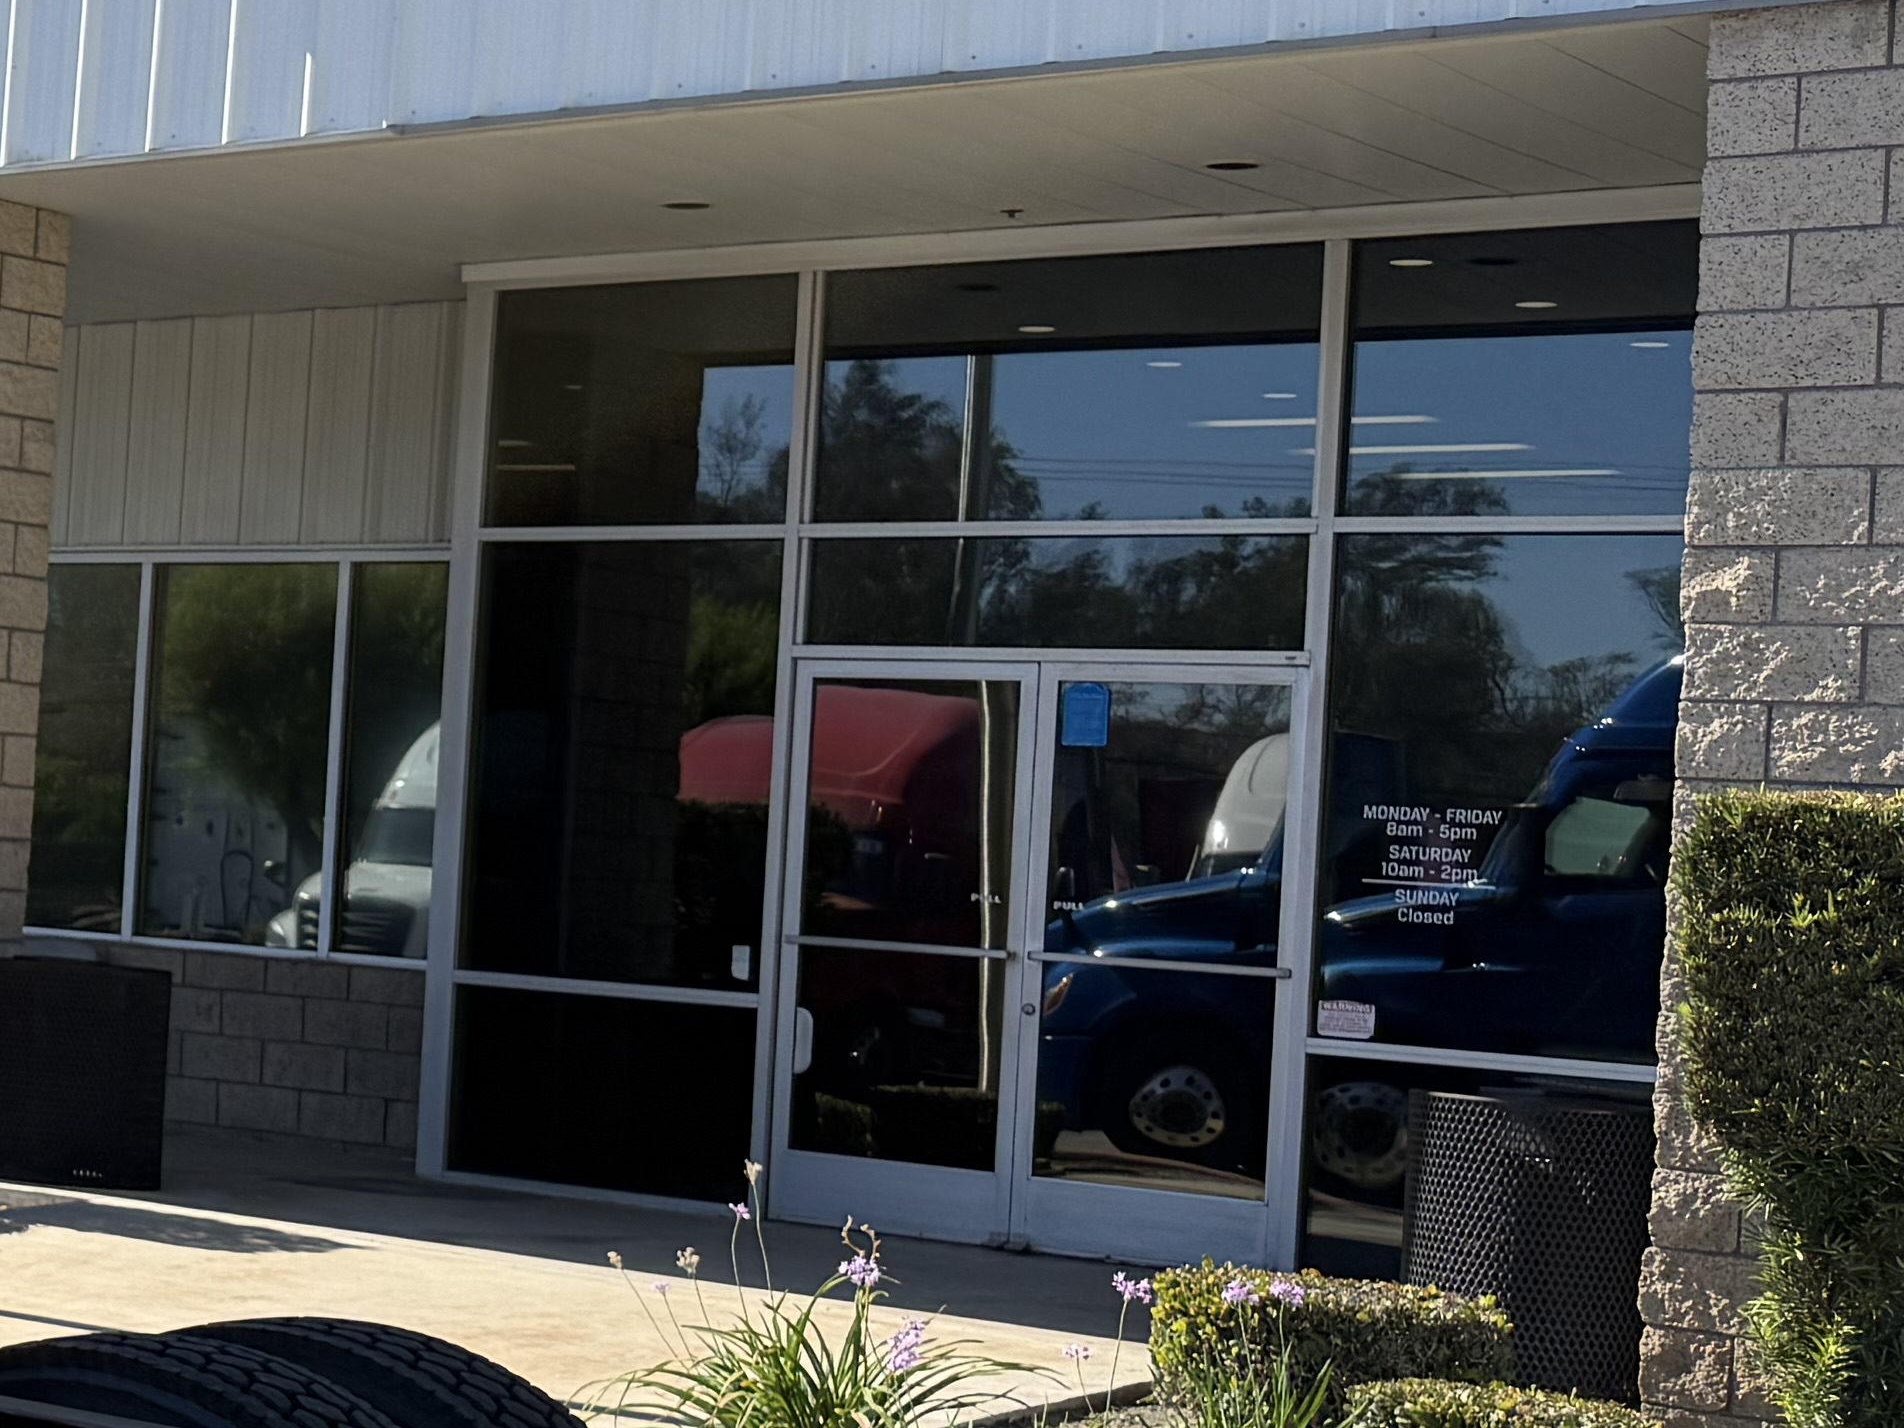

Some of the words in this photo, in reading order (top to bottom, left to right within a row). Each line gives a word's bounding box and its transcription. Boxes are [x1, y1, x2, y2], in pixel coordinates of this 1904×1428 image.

[1363, 804, 1430, 822] MONDAY
[1446, 808, 1503, 825] FRIDAY
[1386, 821, 1423, 837] 8am
[1439, 823, 1478, 842] 5pm
[1389, 844, 1472, 863] SATURDAY
[1381, 861, 1424, 878] 10am
[1440, 864, 1479, 882] 2pm
[1053, 900, 1085, 911] PULL
[1395, 888, 1460, 907] SUNDAY
[1398, 907, 1455, 925] Closed
